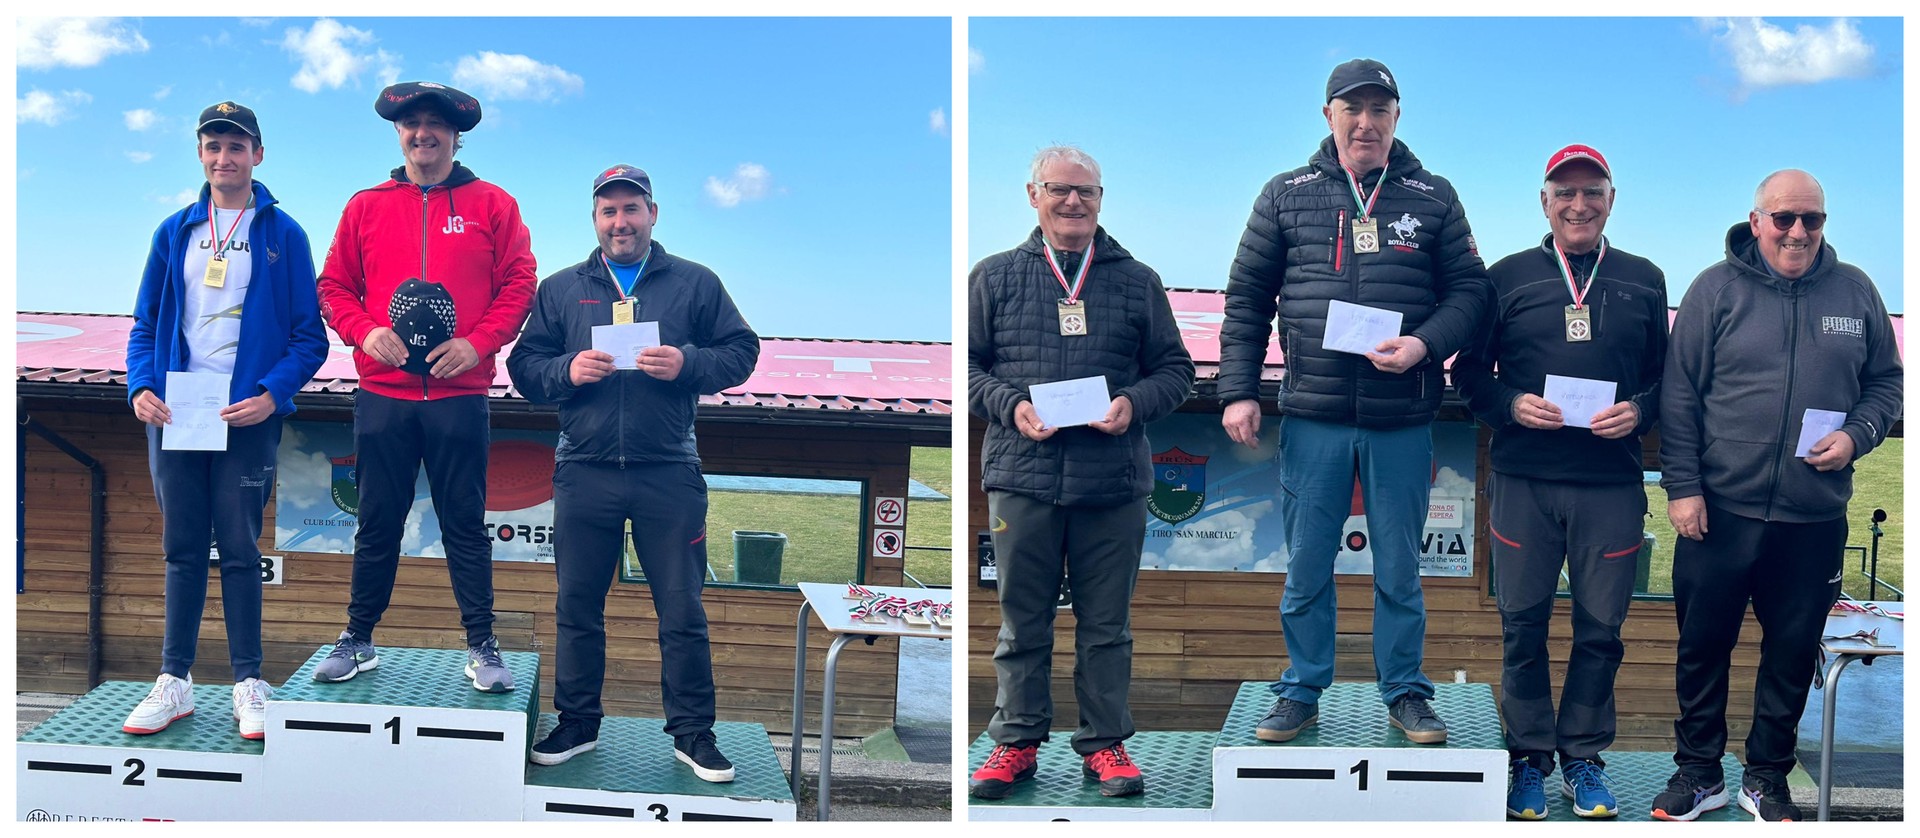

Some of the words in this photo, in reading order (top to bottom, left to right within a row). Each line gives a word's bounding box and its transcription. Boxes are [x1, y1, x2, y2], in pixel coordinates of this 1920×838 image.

[442, 215, 465, 234] JG
[409, 333, 427, 346] JG
[303, 518, 324, 526] CLUB
[325, 519, 336, 527] DE
[337, 519, 355, 527] TIRO
[1151, 529, 1172, 538] TIRO
[1418, 555, 1436, 564] ound
[1436, 555, 1448, 563] the
[1448, 556, 1467, 564] world
[384, 716, 401, 745] 1
[122, 757, 146, 787] 2
[1351, 759, 1368, 791] 1
